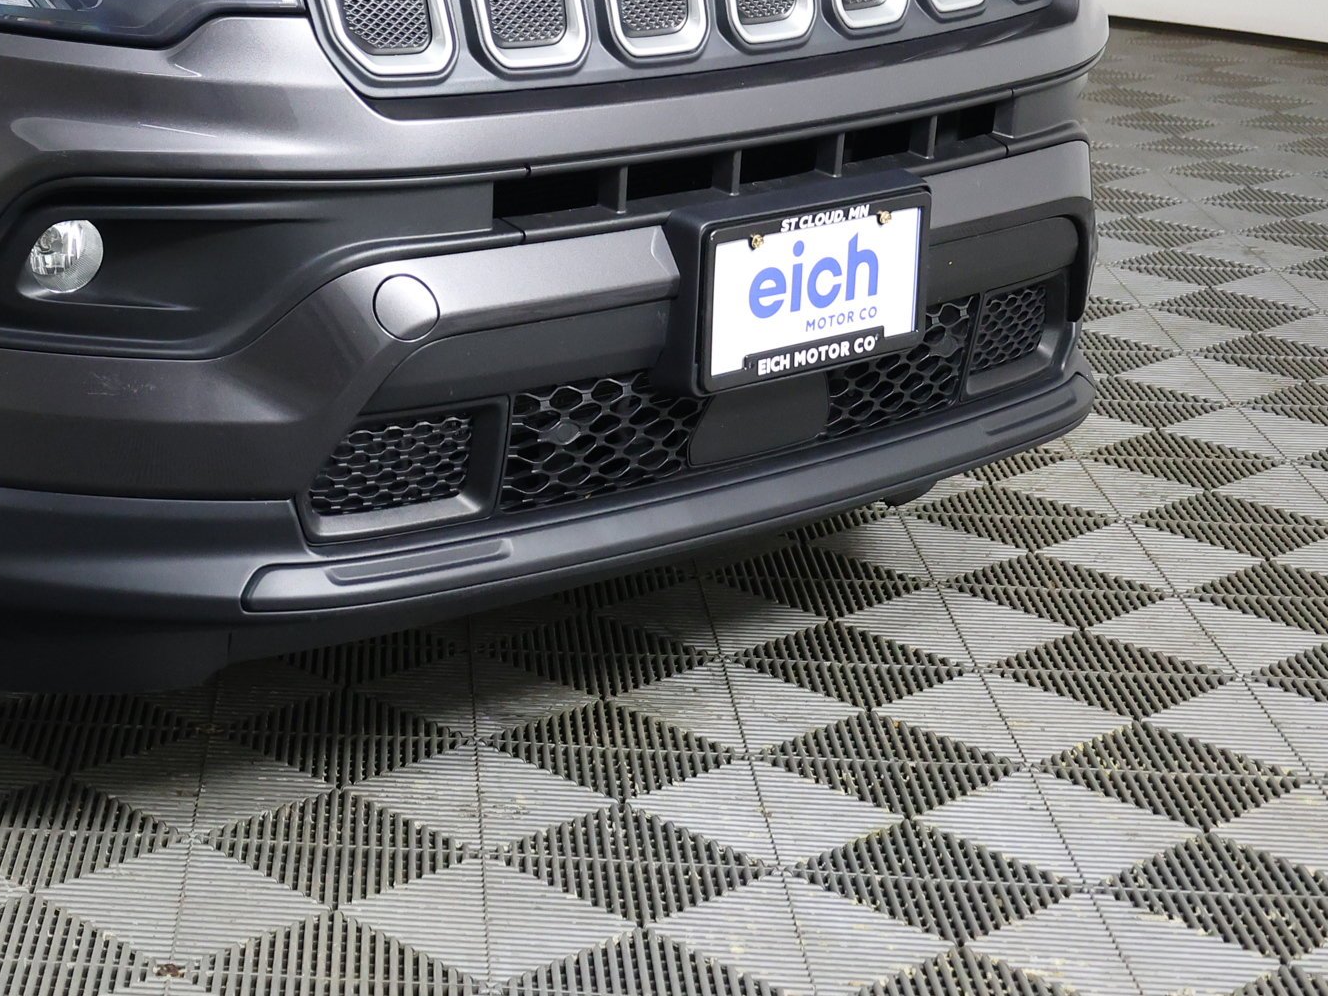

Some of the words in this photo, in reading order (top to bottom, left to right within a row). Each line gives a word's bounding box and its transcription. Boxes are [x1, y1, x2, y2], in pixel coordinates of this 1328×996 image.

[781, 217, 798, 233] ST
[848, 204, 870, 219] MN
[748, 232, 879, 319] eich
[805, 310, 854, 332] MOTOR
[859, 306, 878, 319] CO
[757, 352, 791, 376] EICH
[793, 340, 850, 368] MOTOR
